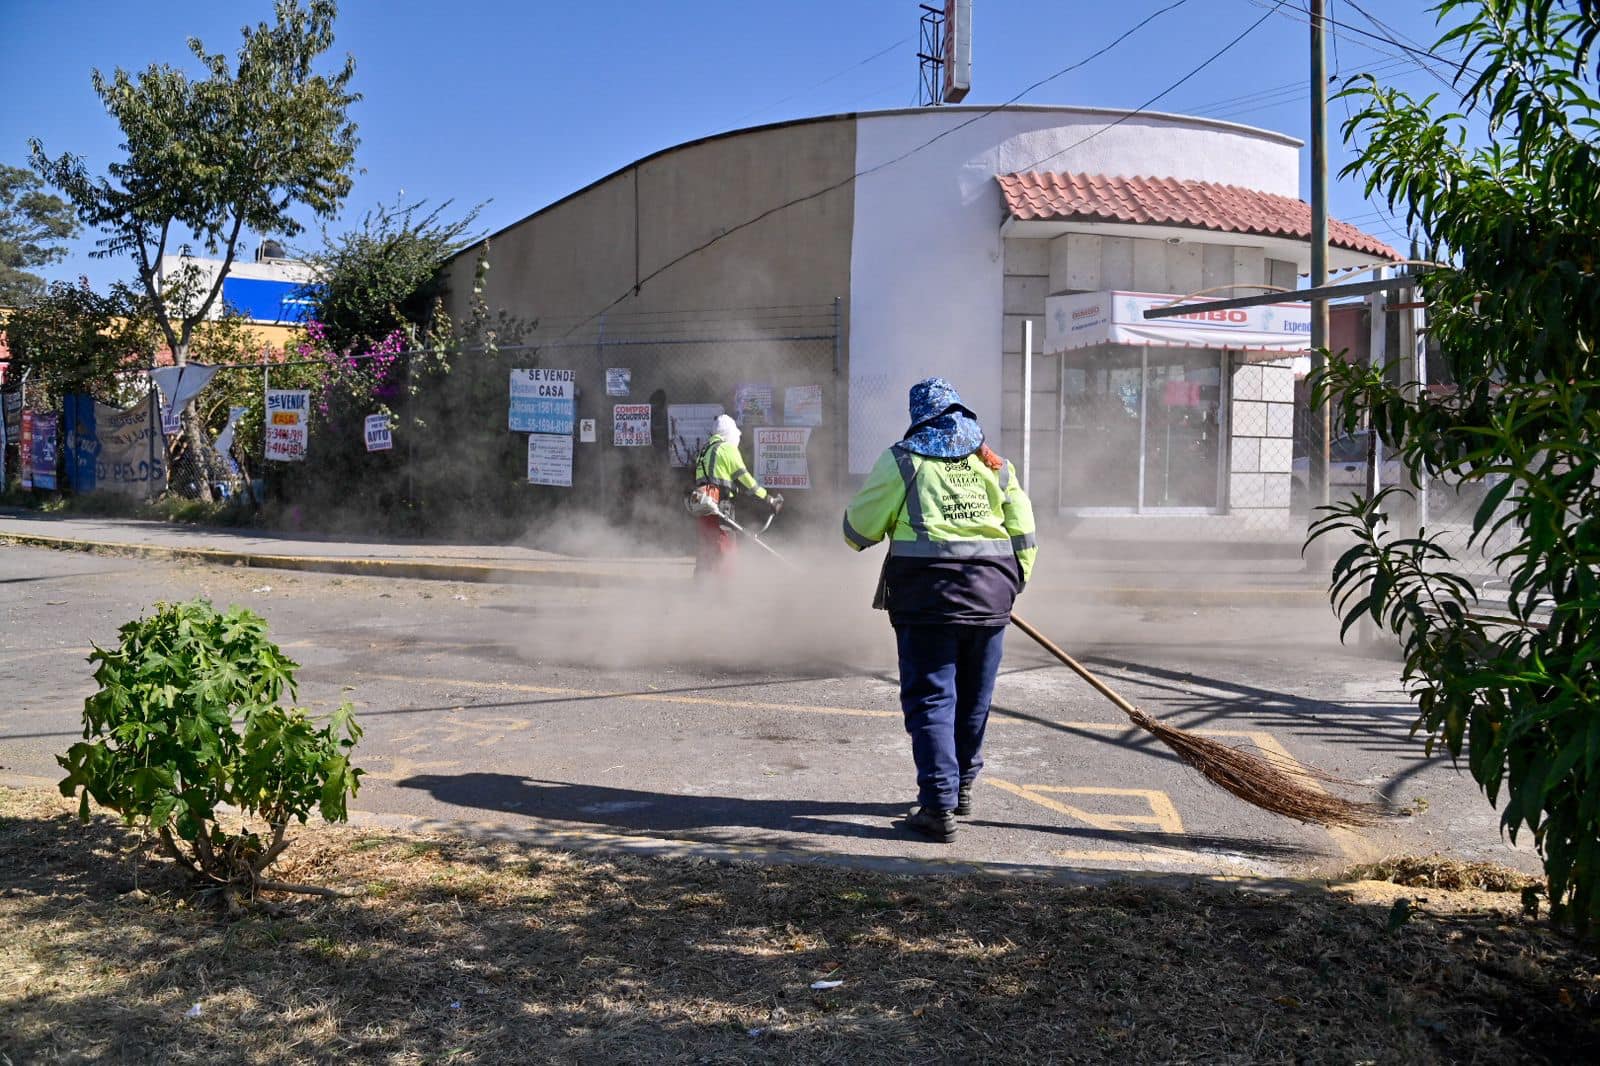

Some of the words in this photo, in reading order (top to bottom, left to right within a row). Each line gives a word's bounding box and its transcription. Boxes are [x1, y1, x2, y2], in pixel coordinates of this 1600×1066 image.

[529, 370, 541, 381] SE
[543, 370, 576, 382] VENDE
[539, 385, 564, 397] CASA
[281, 394, 305, 409] VENDE
[616, 406, 649, 414] COMPRO
[273, 414, 295, 425] CASA
[942, 502, 990, 513] SERVICIOS
